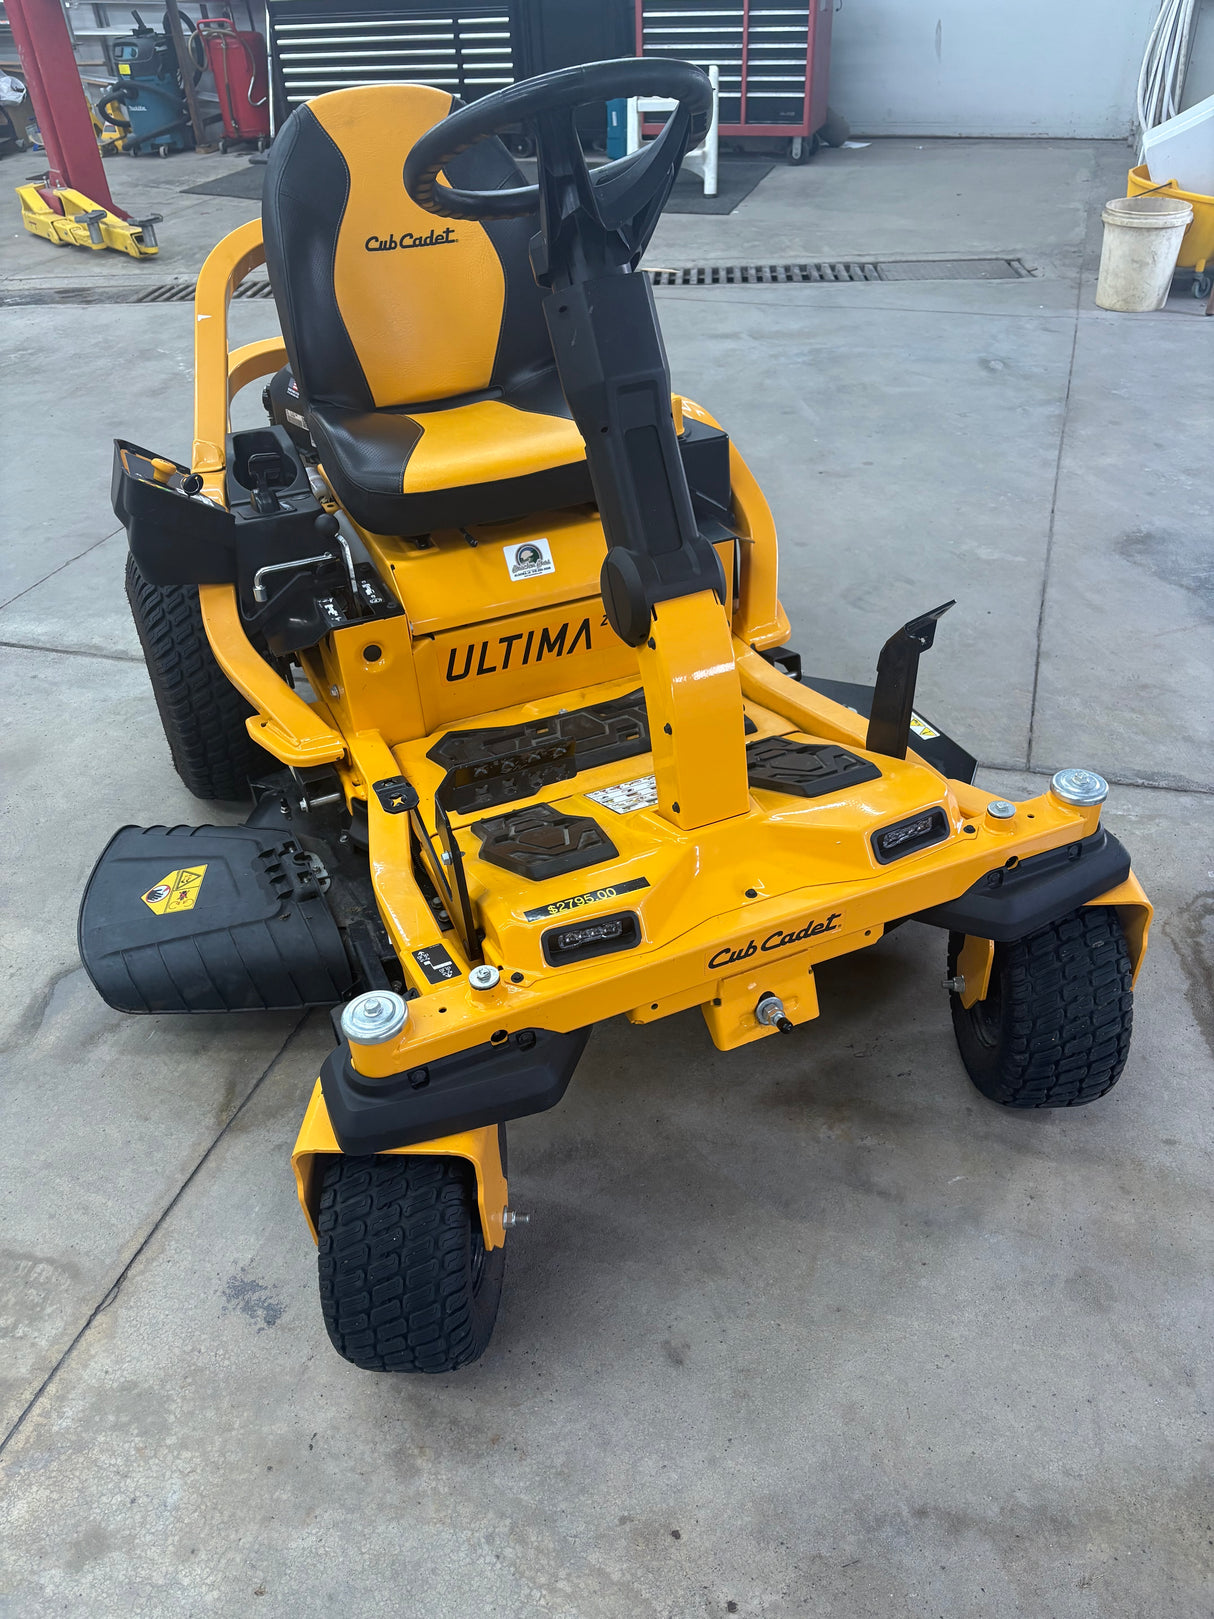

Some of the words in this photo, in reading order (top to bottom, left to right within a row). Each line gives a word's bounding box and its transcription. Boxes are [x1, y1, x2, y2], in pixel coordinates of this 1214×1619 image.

[364, 233, 398, 252] Cub
[399, 227, 457, 249] Cadet
[446, 617, 592, 682] ULTIMA
[547, 887, 617, 915] $2795.00
[707, 939, 758, 970] Cub
[760, 912, 842, 952] Cadet
